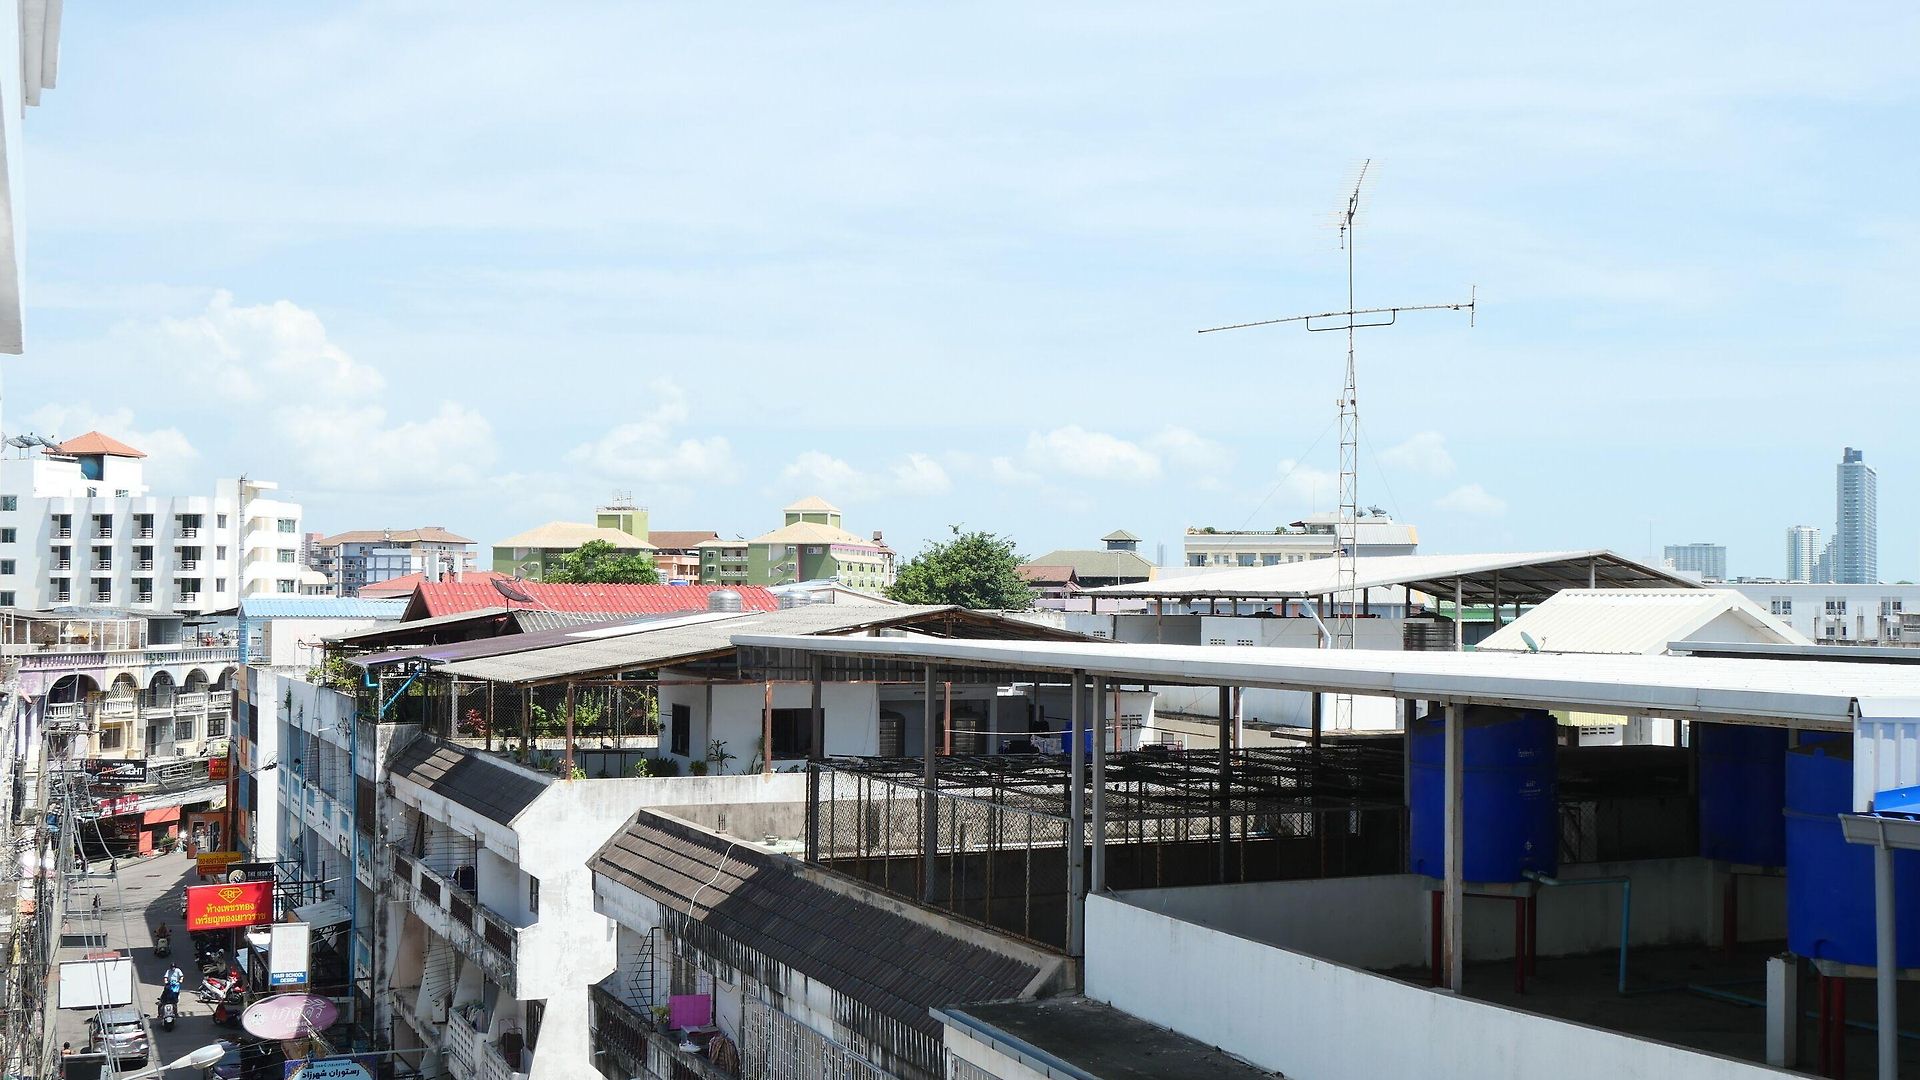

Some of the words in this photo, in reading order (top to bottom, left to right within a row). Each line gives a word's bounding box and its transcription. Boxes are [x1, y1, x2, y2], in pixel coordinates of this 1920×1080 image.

[206, 903, 255, 913] ห้างเพชรทอง
[302, 1070, 327, 1079] شهرزاد
[329, 1069, 360, 1077] رستوران
